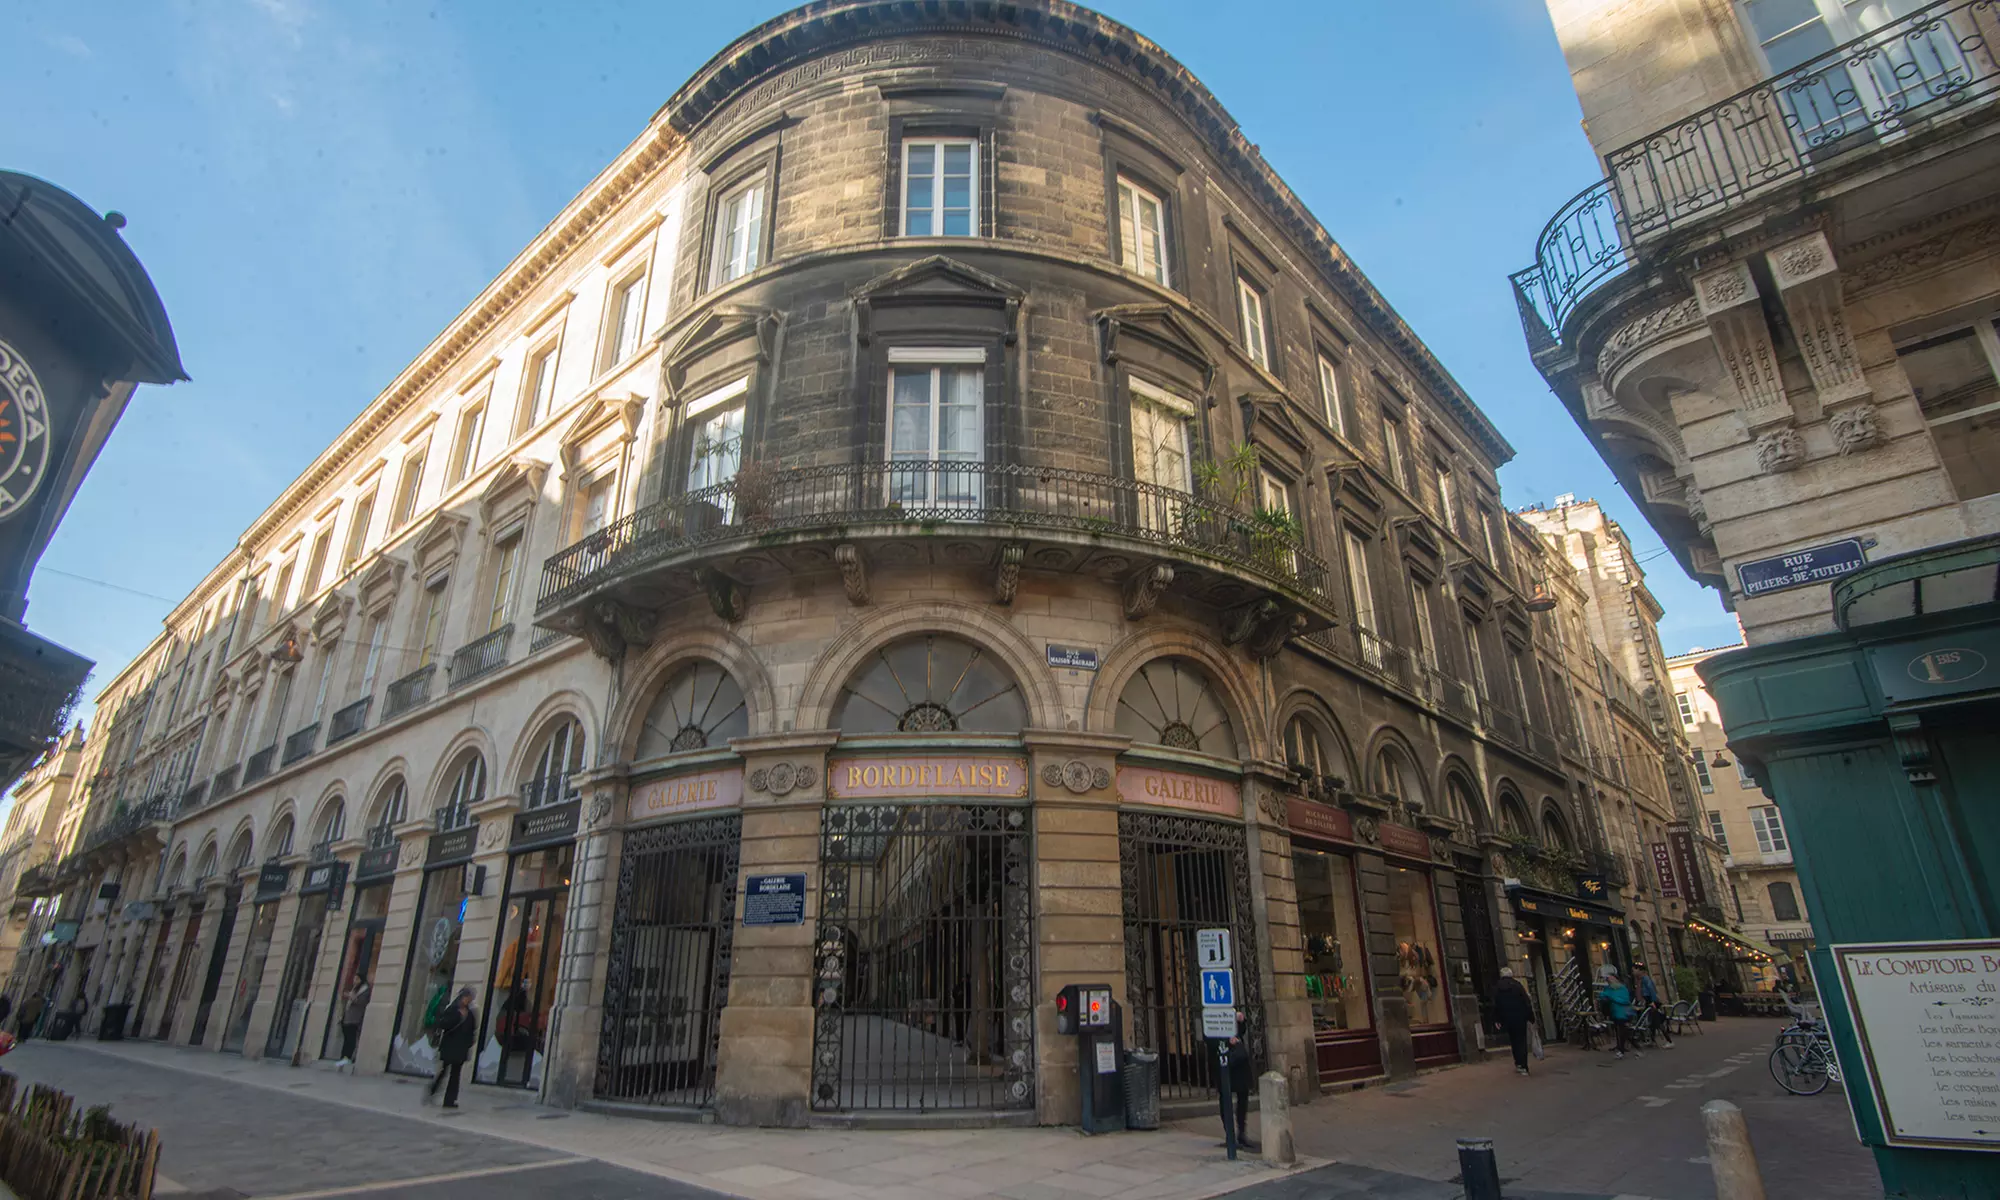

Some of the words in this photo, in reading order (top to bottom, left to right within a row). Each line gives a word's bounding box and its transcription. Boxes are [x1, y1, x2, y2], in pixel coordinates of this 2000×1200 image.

[1783, 553, 1814, 568] RUE
[1792, 565, 1809, 573] DES
[1748, 559, 1861, 592] PILIERS-DE-TUTELLE
[847, 764, 1010, 789] BORDELAISE
[648, 780, 718, 810] GALERIE
[1144, 775, 1221, 806] GALERIE
[1655, 845, 1672, 883] HOTEL
[1774, 928, 1813, 939] minelli
[1855, 959, 1873, 975] LE
[1876, 957, 1977, 975] COMPTOIR
[1910, 980, 1966, 993] Artisans
[1976, 979, 1997, 993] du
